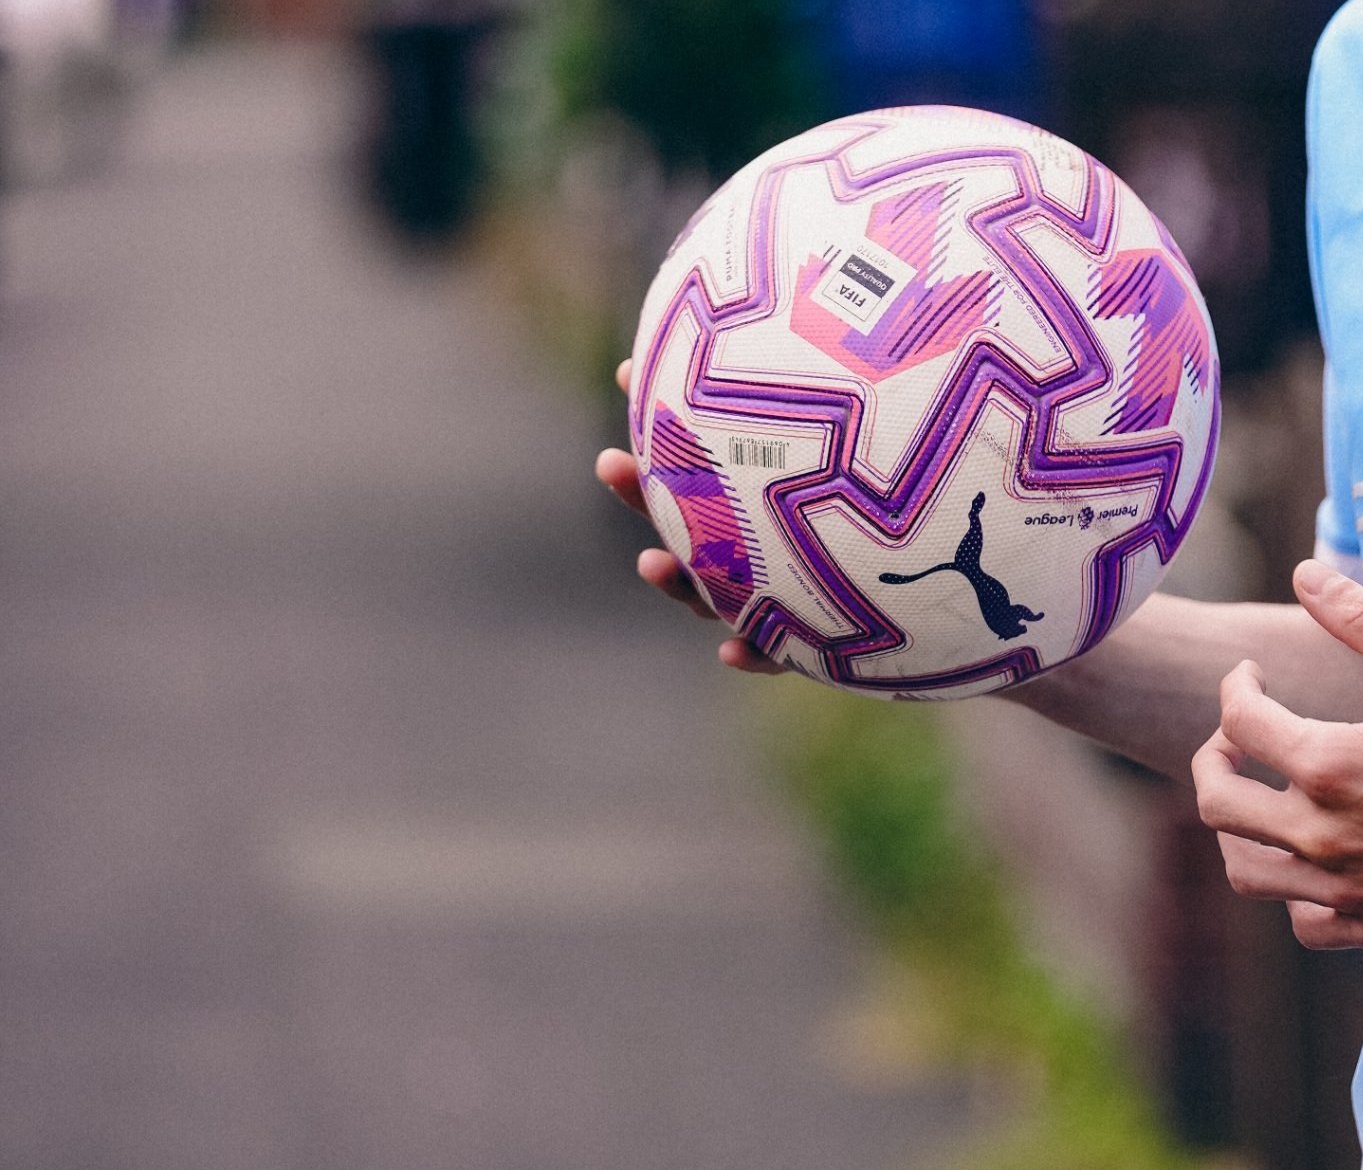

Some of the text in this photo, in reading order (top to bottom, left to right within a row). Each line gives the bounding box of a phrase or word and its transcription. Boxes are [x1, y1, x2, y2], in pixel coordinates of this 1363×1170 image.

[846, 261, 888, 291] QUALITY PRO
[838, 283, 867, 308] FIFA
[1012, 288, 1028, 305] FOR
[1025, 304, 1062, 354] ENGINEERED
[1024, 503, 1139, 528] Premier League
[786, 563, 845, 630] THERMAL BONDED
